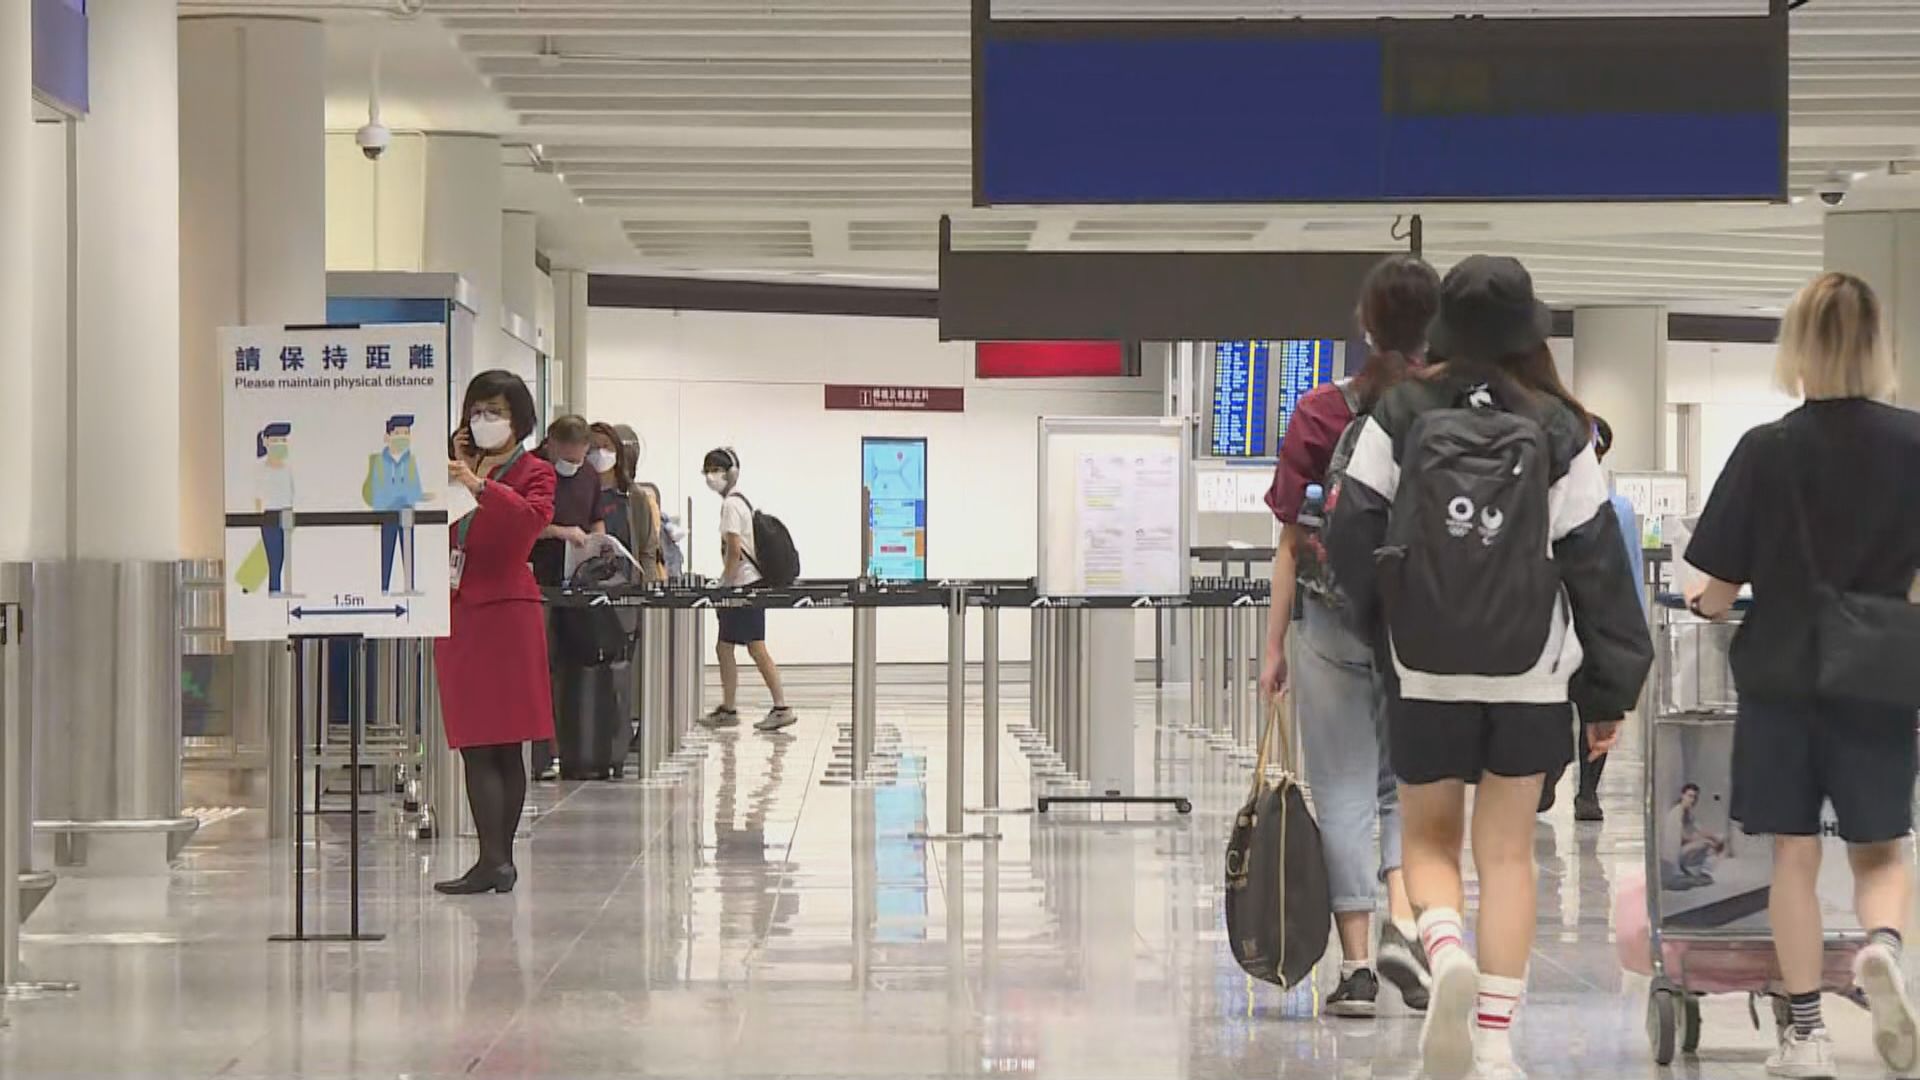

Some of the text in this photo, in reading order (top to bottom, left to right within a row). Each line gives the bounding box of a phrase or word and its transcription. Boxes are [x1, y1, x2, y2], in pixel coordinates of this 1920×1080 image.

[235, 344, 434, 372] 請保持距離
[235, 374, 434, 389] Please maintain physical distance
[333, 593, 364, 607] 1.5m
